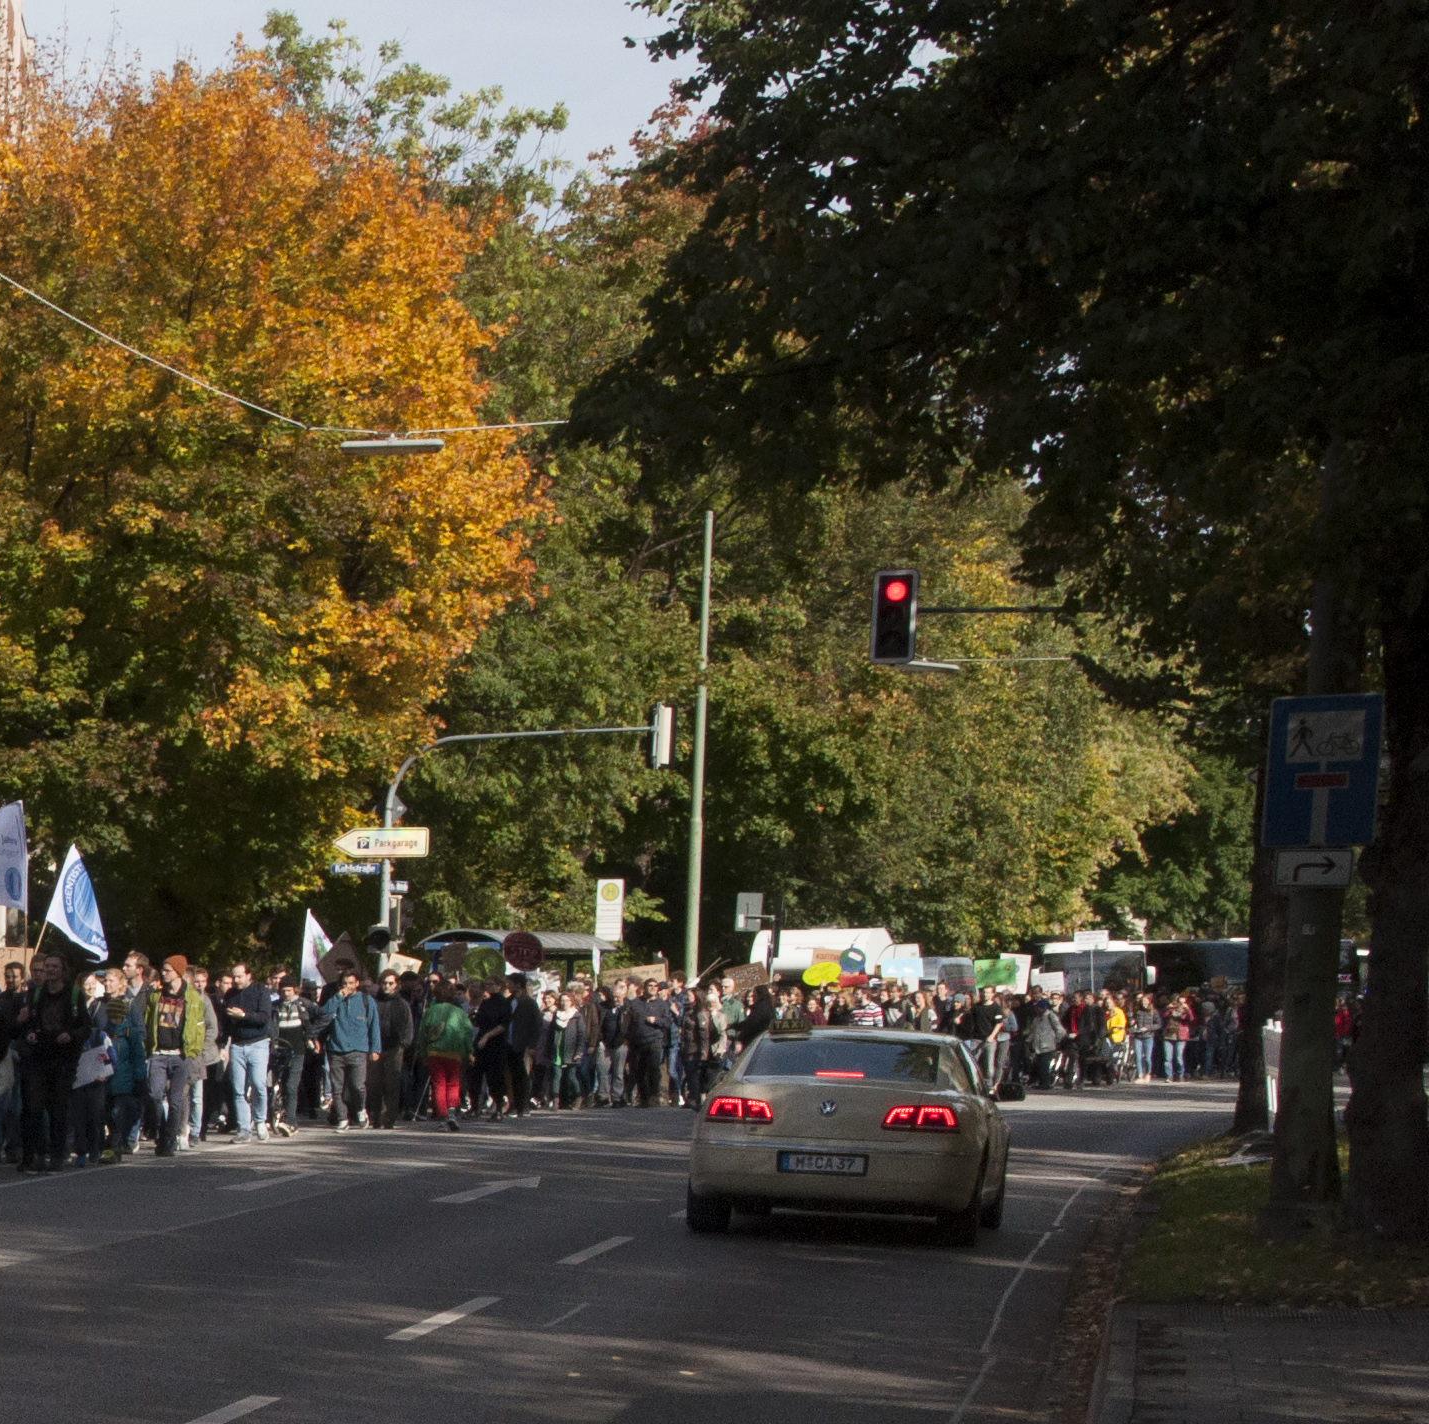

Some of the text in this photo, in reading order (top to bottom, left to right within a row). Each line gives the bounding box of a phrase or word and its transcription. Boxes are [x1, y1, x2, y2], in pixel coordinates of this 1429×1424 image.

[374, 839, 418, 849] Parkgarage
[774, 1020, 804, 1029] TAXI
[814, 1157, 833, 1169] CA
[836, 1158, 855, 1170] 37
